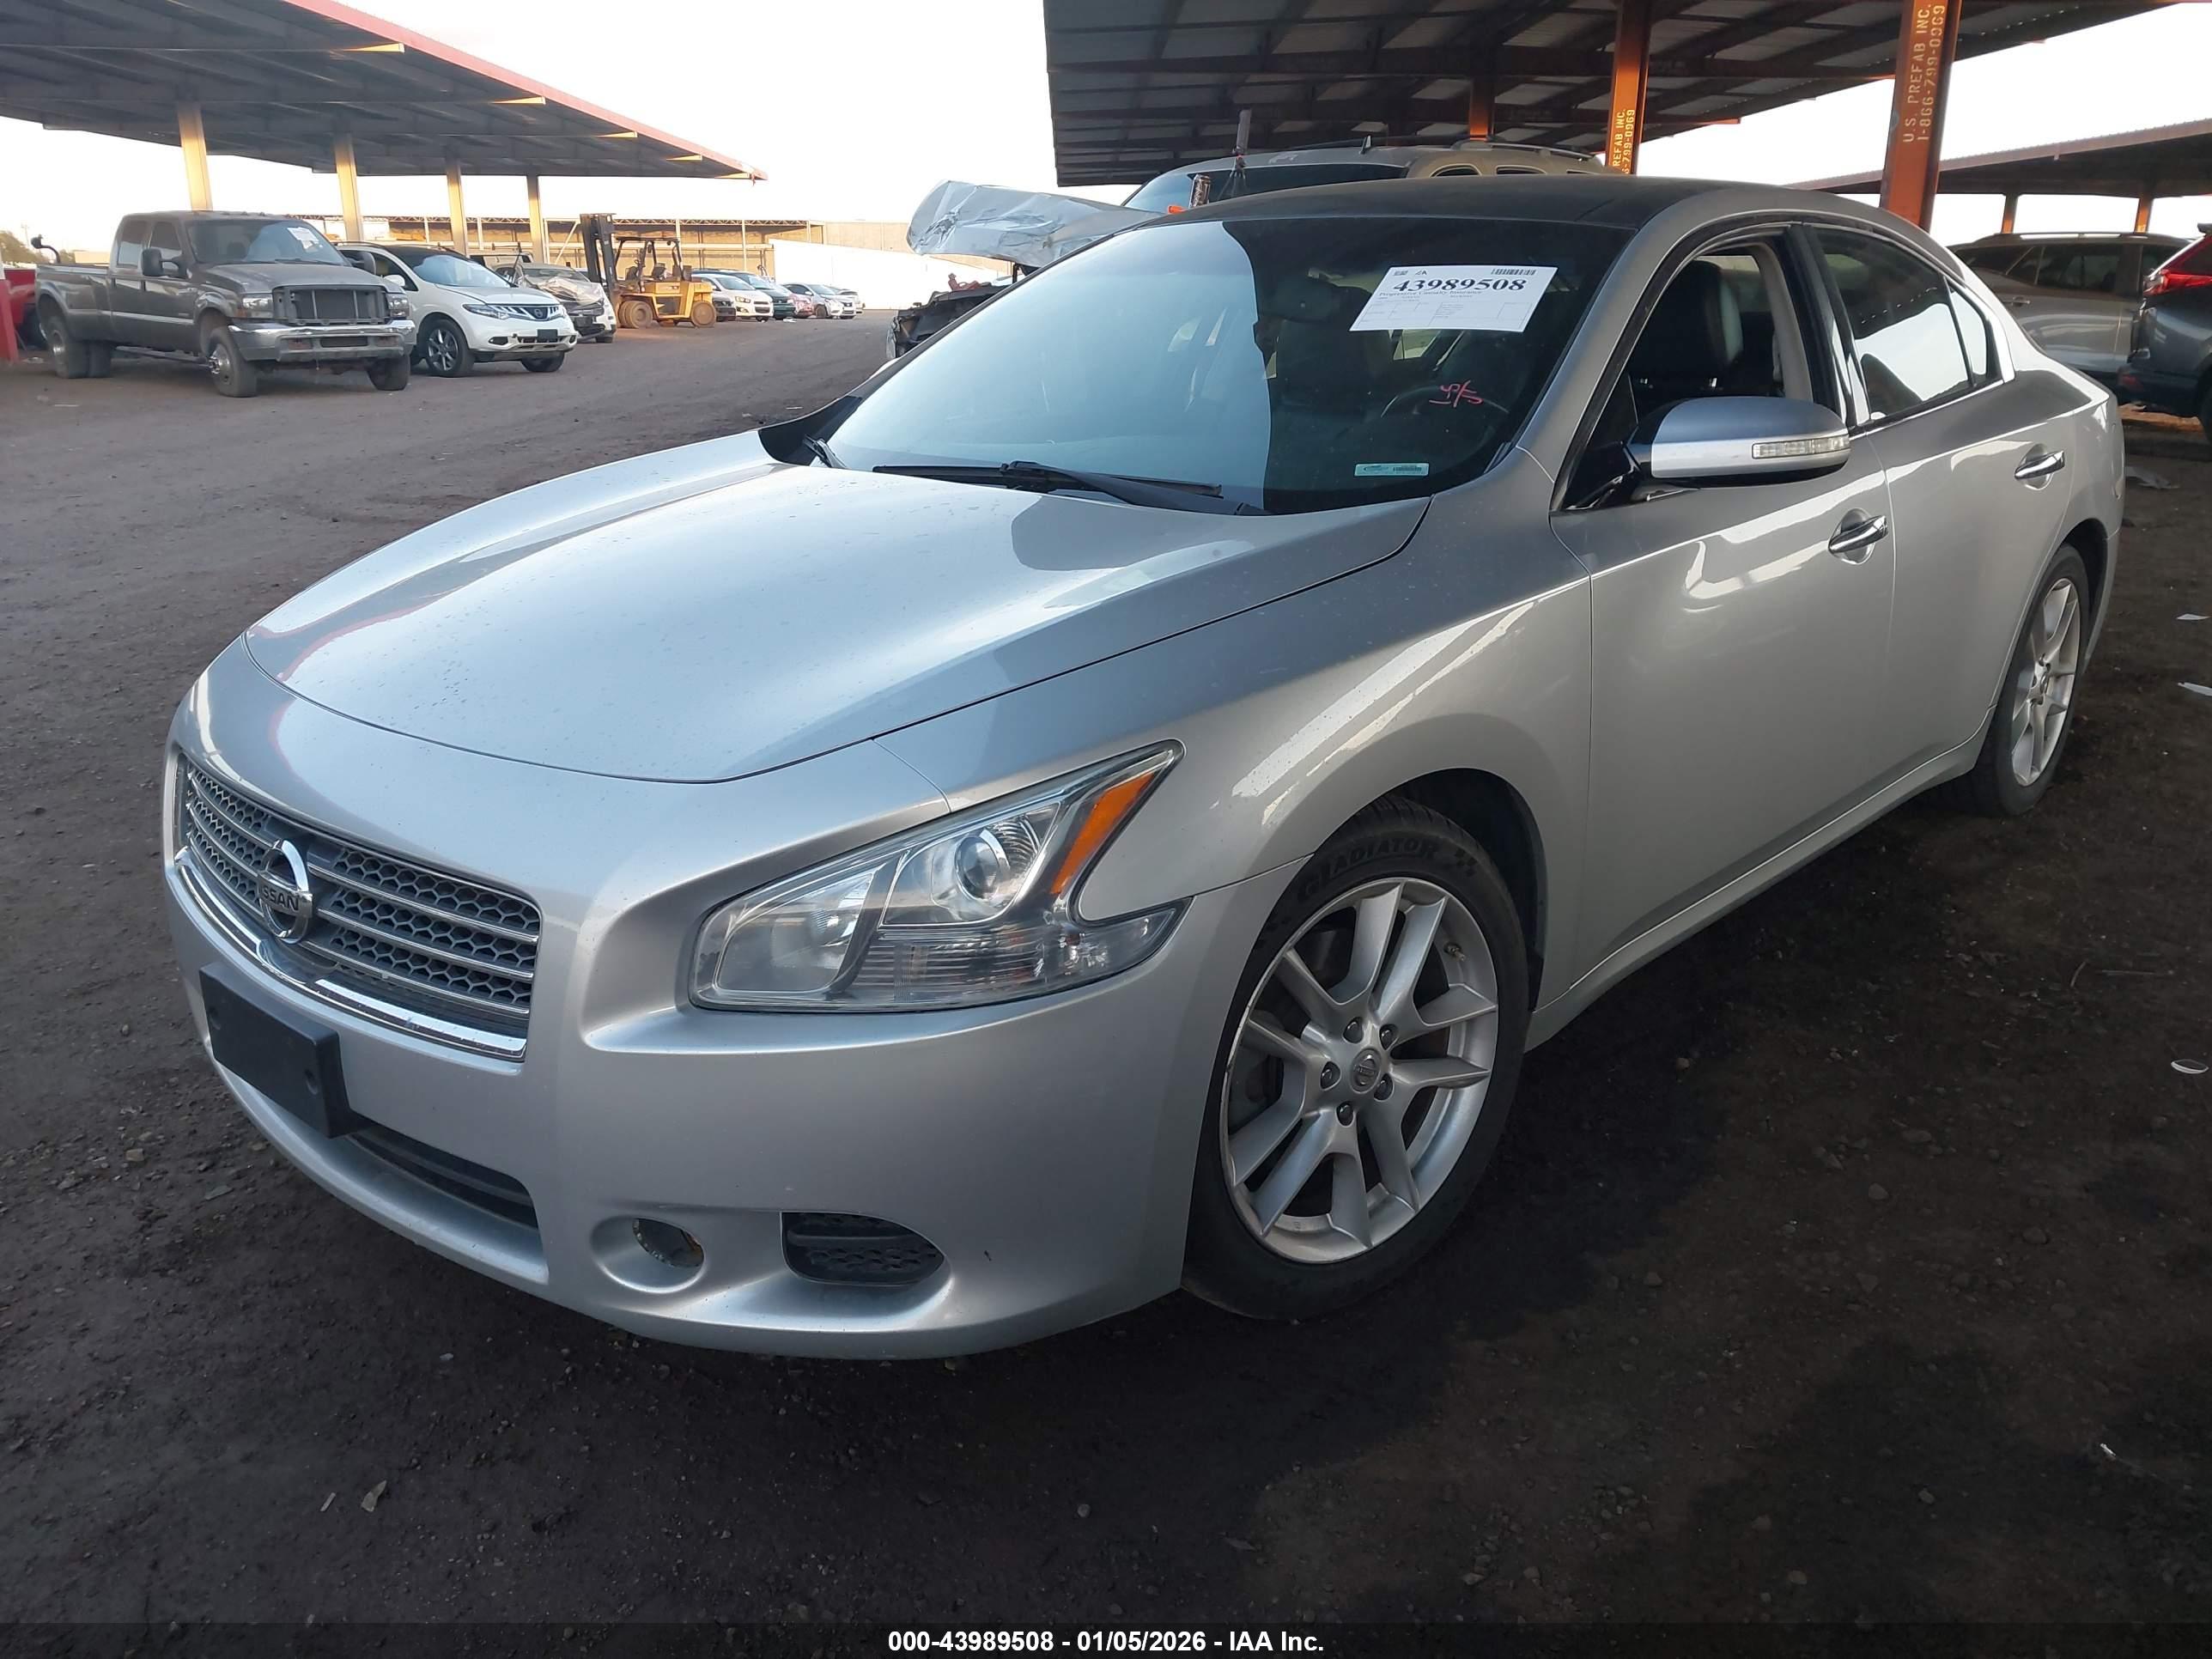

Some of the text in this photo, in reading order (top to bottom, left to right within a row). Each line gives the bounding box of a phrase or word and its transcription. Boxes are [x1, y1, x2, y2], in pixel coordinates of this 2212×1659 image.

[1903, 3, 1931, 143] U.S. PREFAB INC.
[1613, 108, 1626, 167] REFAB INC.
[1393, 278, 1527, 292] 43989508
